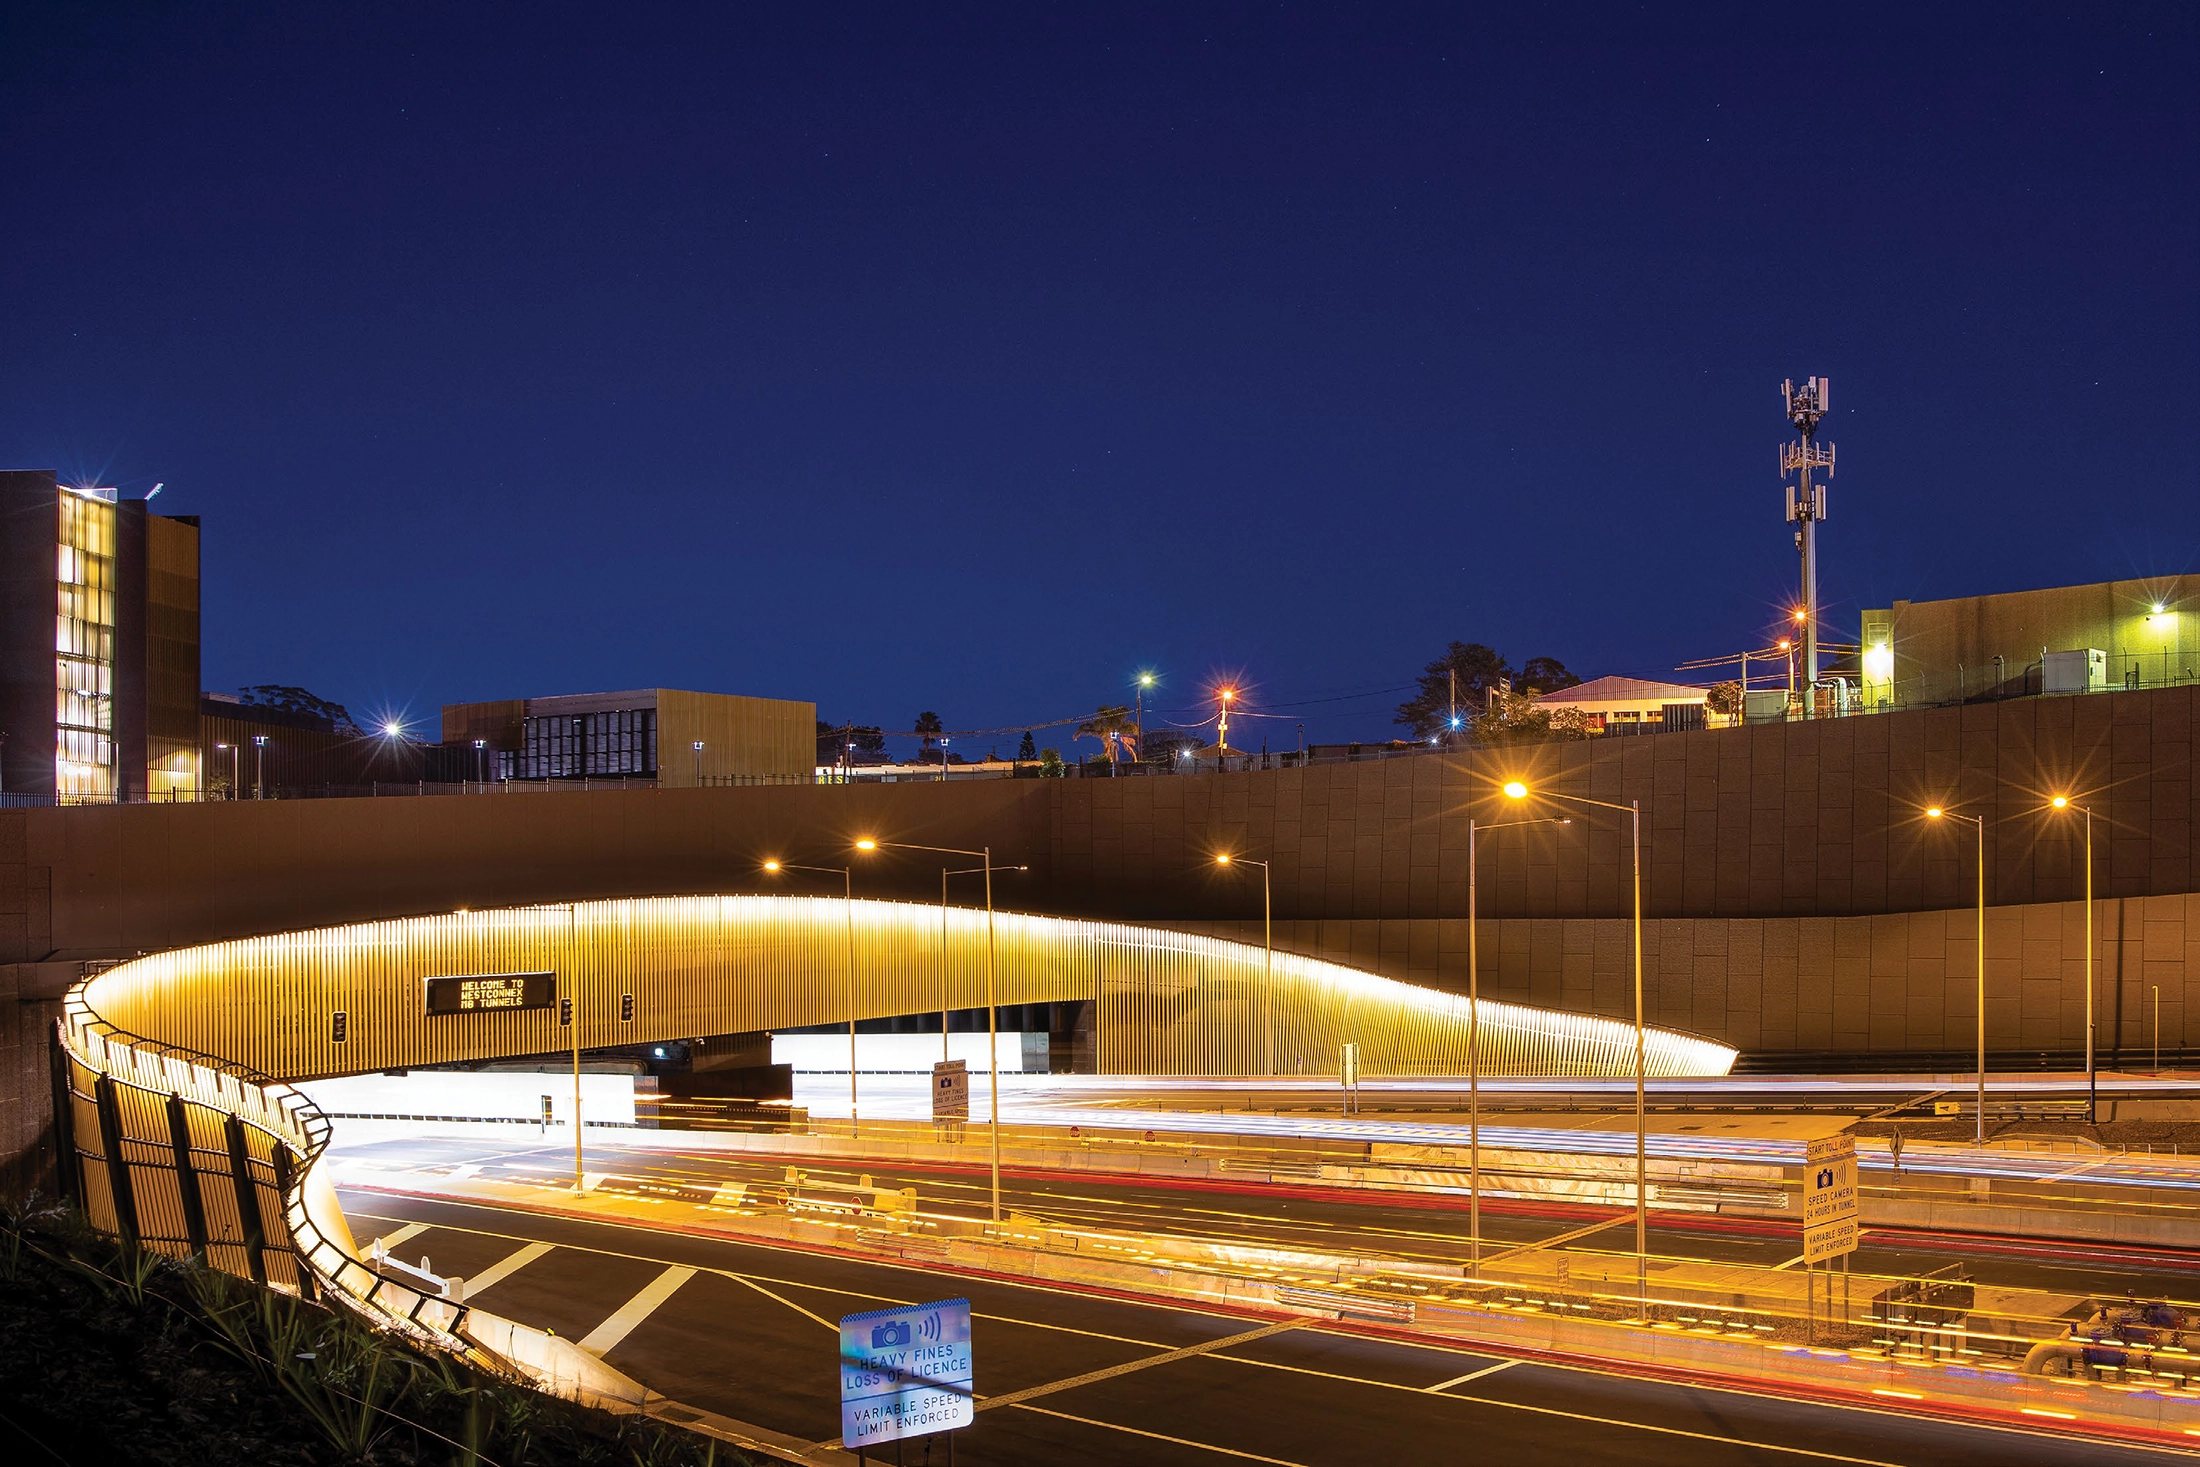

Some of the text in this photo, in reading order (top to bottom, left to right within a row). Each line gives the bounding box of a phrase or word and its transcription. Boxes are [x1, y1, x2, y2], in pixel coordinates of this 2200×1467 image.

[461, 979, 524, 991] WELCOME TO
[461, 988, 523, 1000] WESTCONNEX
[461, 997, 523, 1009] M8 TUNNELS
[1808, 1138, 1855, 1156] START TOLL POINT
[1808, 1187, 1853, 1206] SPEED CAMERA
[1806, 1199, 1856, 1220] 24 HOURS IN TUNNEL
[1808, 1224, 1854, 1244] VARIABLE SPEED
[1810, 1237, 1852, 1256] LIMIT ENFORCED
[860, 1345, 953, 1370] HEAVY FINES
[846, 1358, 967, 1390] LOSS OF LICENCE
[854, 1392, 962, 1422] VARIABLE SPEED
[857, 1408, 959, 1437] LIMIT ENFORCED
